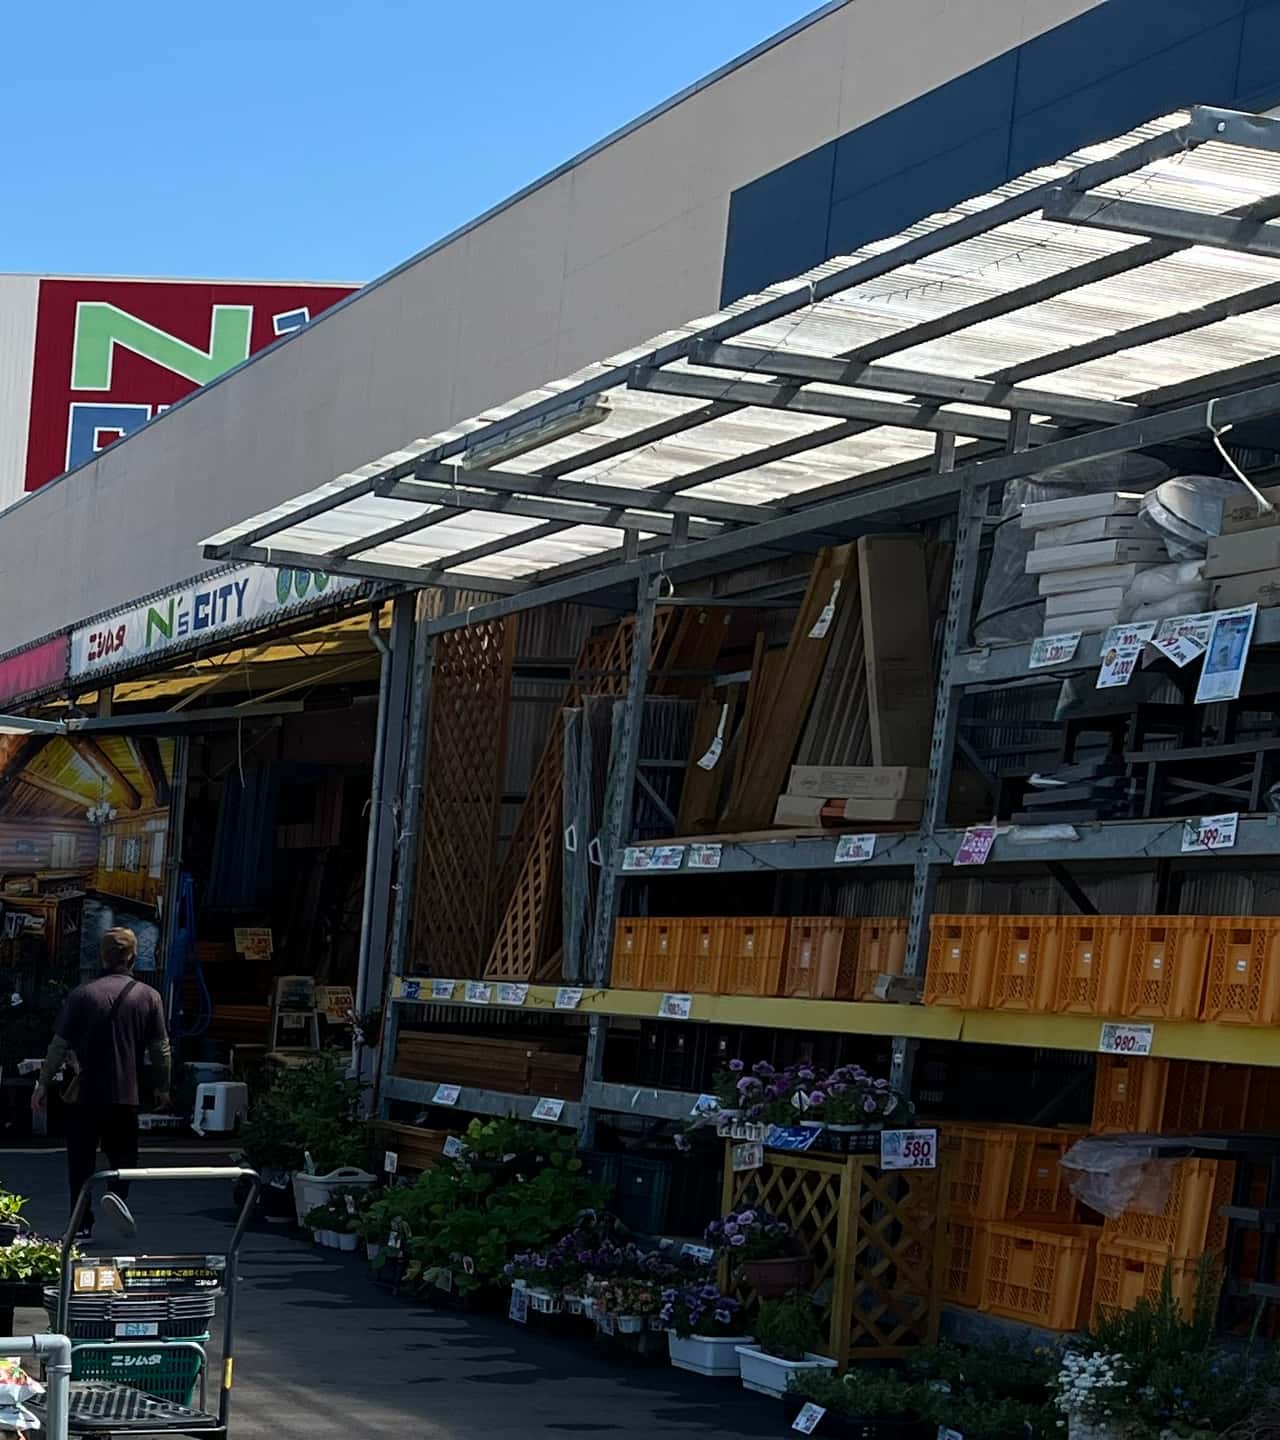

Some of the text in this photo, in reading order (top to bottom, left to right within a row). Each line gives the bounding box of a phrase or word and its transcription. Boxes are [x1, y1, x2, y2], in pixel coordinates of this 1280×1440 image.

[88, 624, 126, 661] ニシムタ
[193, 577, 250, 631] CITY
[1113, 1035, 1136, 1051] 980
[903, 1142, 931, 1158] 580
[111, 1354, 162, 1367] ニシムタ
